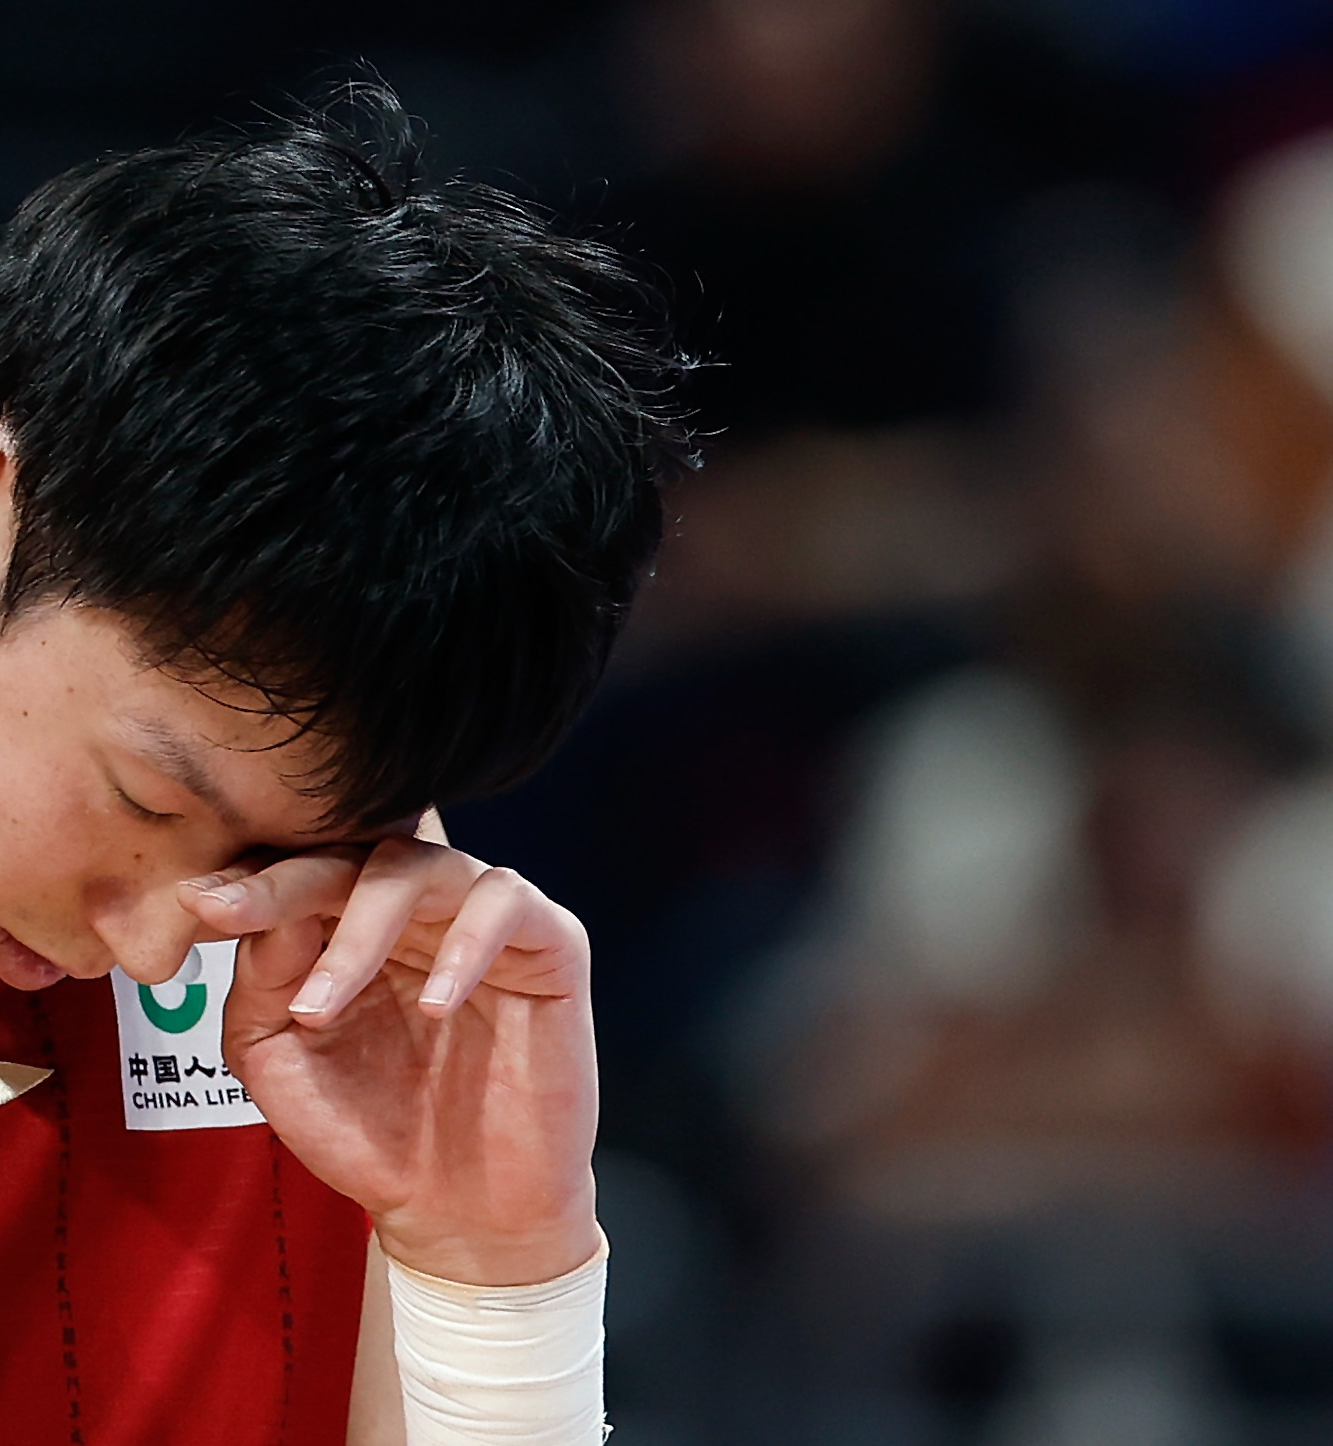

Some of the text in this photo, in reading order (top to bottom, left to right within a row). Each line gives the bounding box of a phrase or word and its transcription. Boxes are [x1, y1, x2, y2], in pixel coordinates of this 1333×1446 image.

[128, 1052, 231, 1086] 中国人
[132, 1090, 199, 1110] CHINA
